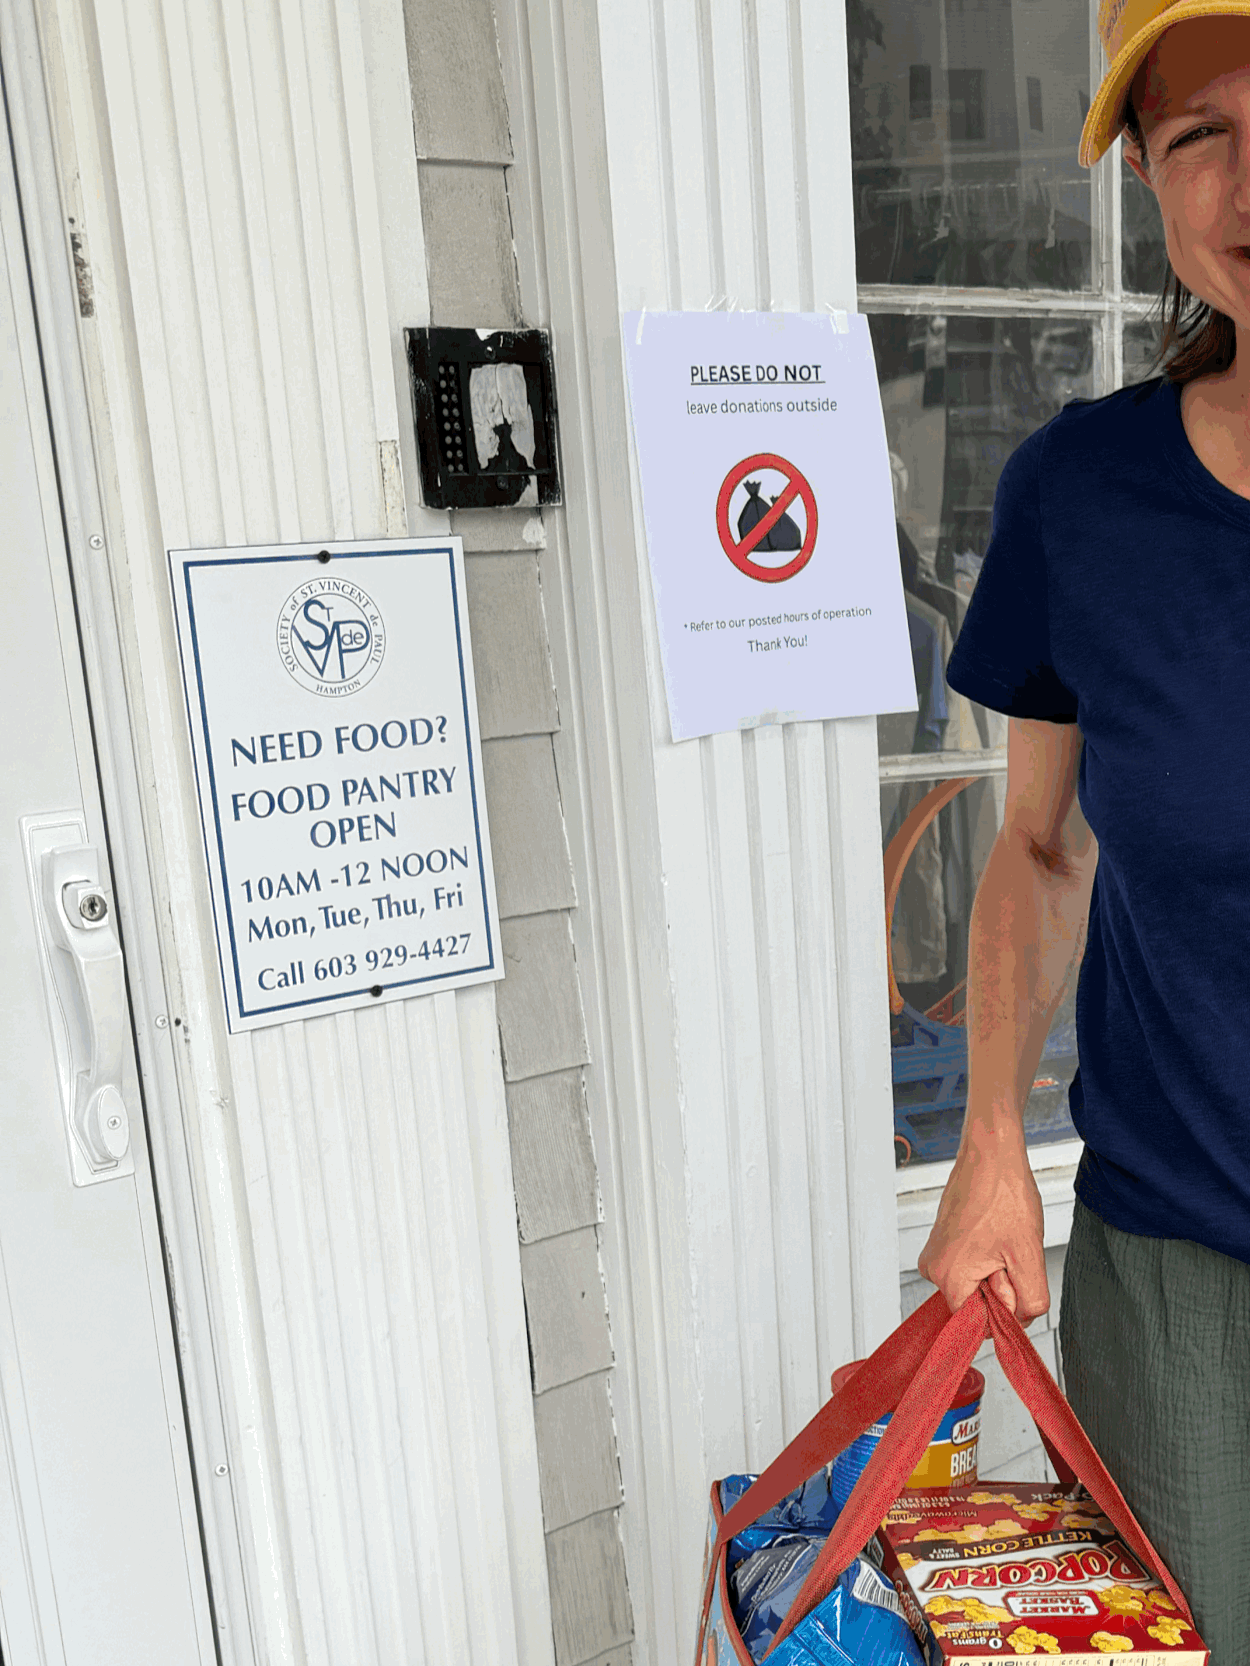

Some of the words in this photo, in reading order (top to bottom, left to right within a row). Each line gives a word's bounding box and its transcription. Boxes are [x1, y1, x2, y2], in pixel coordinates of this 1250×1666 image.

[691, 365, 752, 383] PLEASE
[755, 364, 778, 382] DO
[784, 364, 822, 381] NOT
[686, 400, 718, 415] leave
[720, 399, 783, 414] donations
[786, 397, 838, 412] outside
[300, 584, 317, 599] ST.
[318, 580, 372, 609] VINCENT
[290, 596, 300, 611] of
[369, 614, 379, 627] de
[690, 620, 715, 632] Refer
[716, 618, 727, 630] to
[728, 618, 746, 628] our
[748, 613, 782, 629] posted
[783, 611, 810, 624] hours
[811, 609, 822, 621] of
[823, 606, 872, 621] operation
[279, 614, 298, 672] SOCIETY
[370, 633, 383, 665] PAUL
[747, 637, 782, 652] Thank
[783, 634, 808, 650] You!
[315, 679, 361, 695] HAMPTON
[230, 730, 323, 767] NEED
[334, 715, 448, 754] FOOD?
[231, 783, 330, 821] FOOD
[341, 766, 457, 806] PANTRY
[310, 811, 397, 848] OPEN
[241, 868, 321, 903] 10AM
[381, 846, 469, 881] NOON
[248, 915, 316, 943] Mon,
[318, 905, 370, 929] Tue,
[371, 893, 426, 919] Thu,
[433, 882, 464, 910] Fri
[257, 960, 305, 991] Call
[313, 953, 357, 981] 603
[365, 932, 472, 971] 929-4427
[950, 1443, 978, 1478] BREA
[963, 1541, 1020, 1559] CORN
[1022, 1531, 1093, 1548] KETTLE
[922, 1540, 1150, 1592] POPCORN
[1019, 1597, 1084, 1606] BASKET
[1019, 1605, 1091, 1615] MARKET
[952, 1637, 987, 1646] grams
